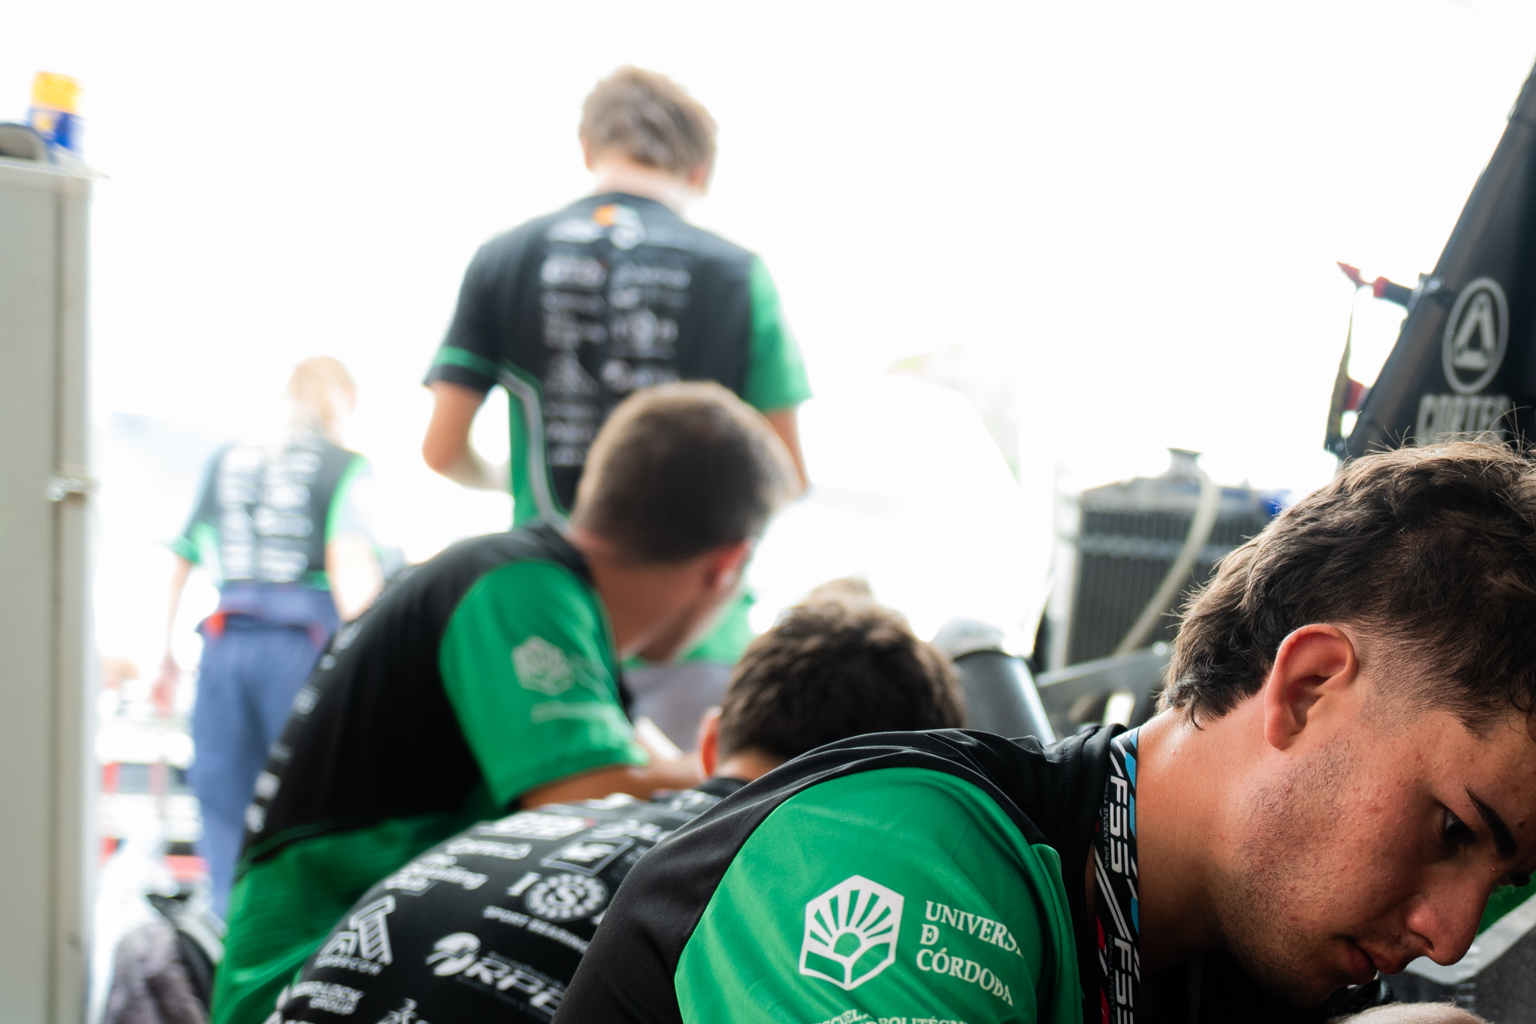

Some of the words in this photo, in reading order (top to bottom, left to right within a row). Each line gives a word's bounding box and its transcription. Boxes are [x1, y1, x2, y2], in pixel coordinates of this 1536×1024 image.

[1416, 393, 1511, 443] CORTEC
[1110, 775, 1129, 876] FSS
[916, 947, 1013, 1006] CÓRDOBA
